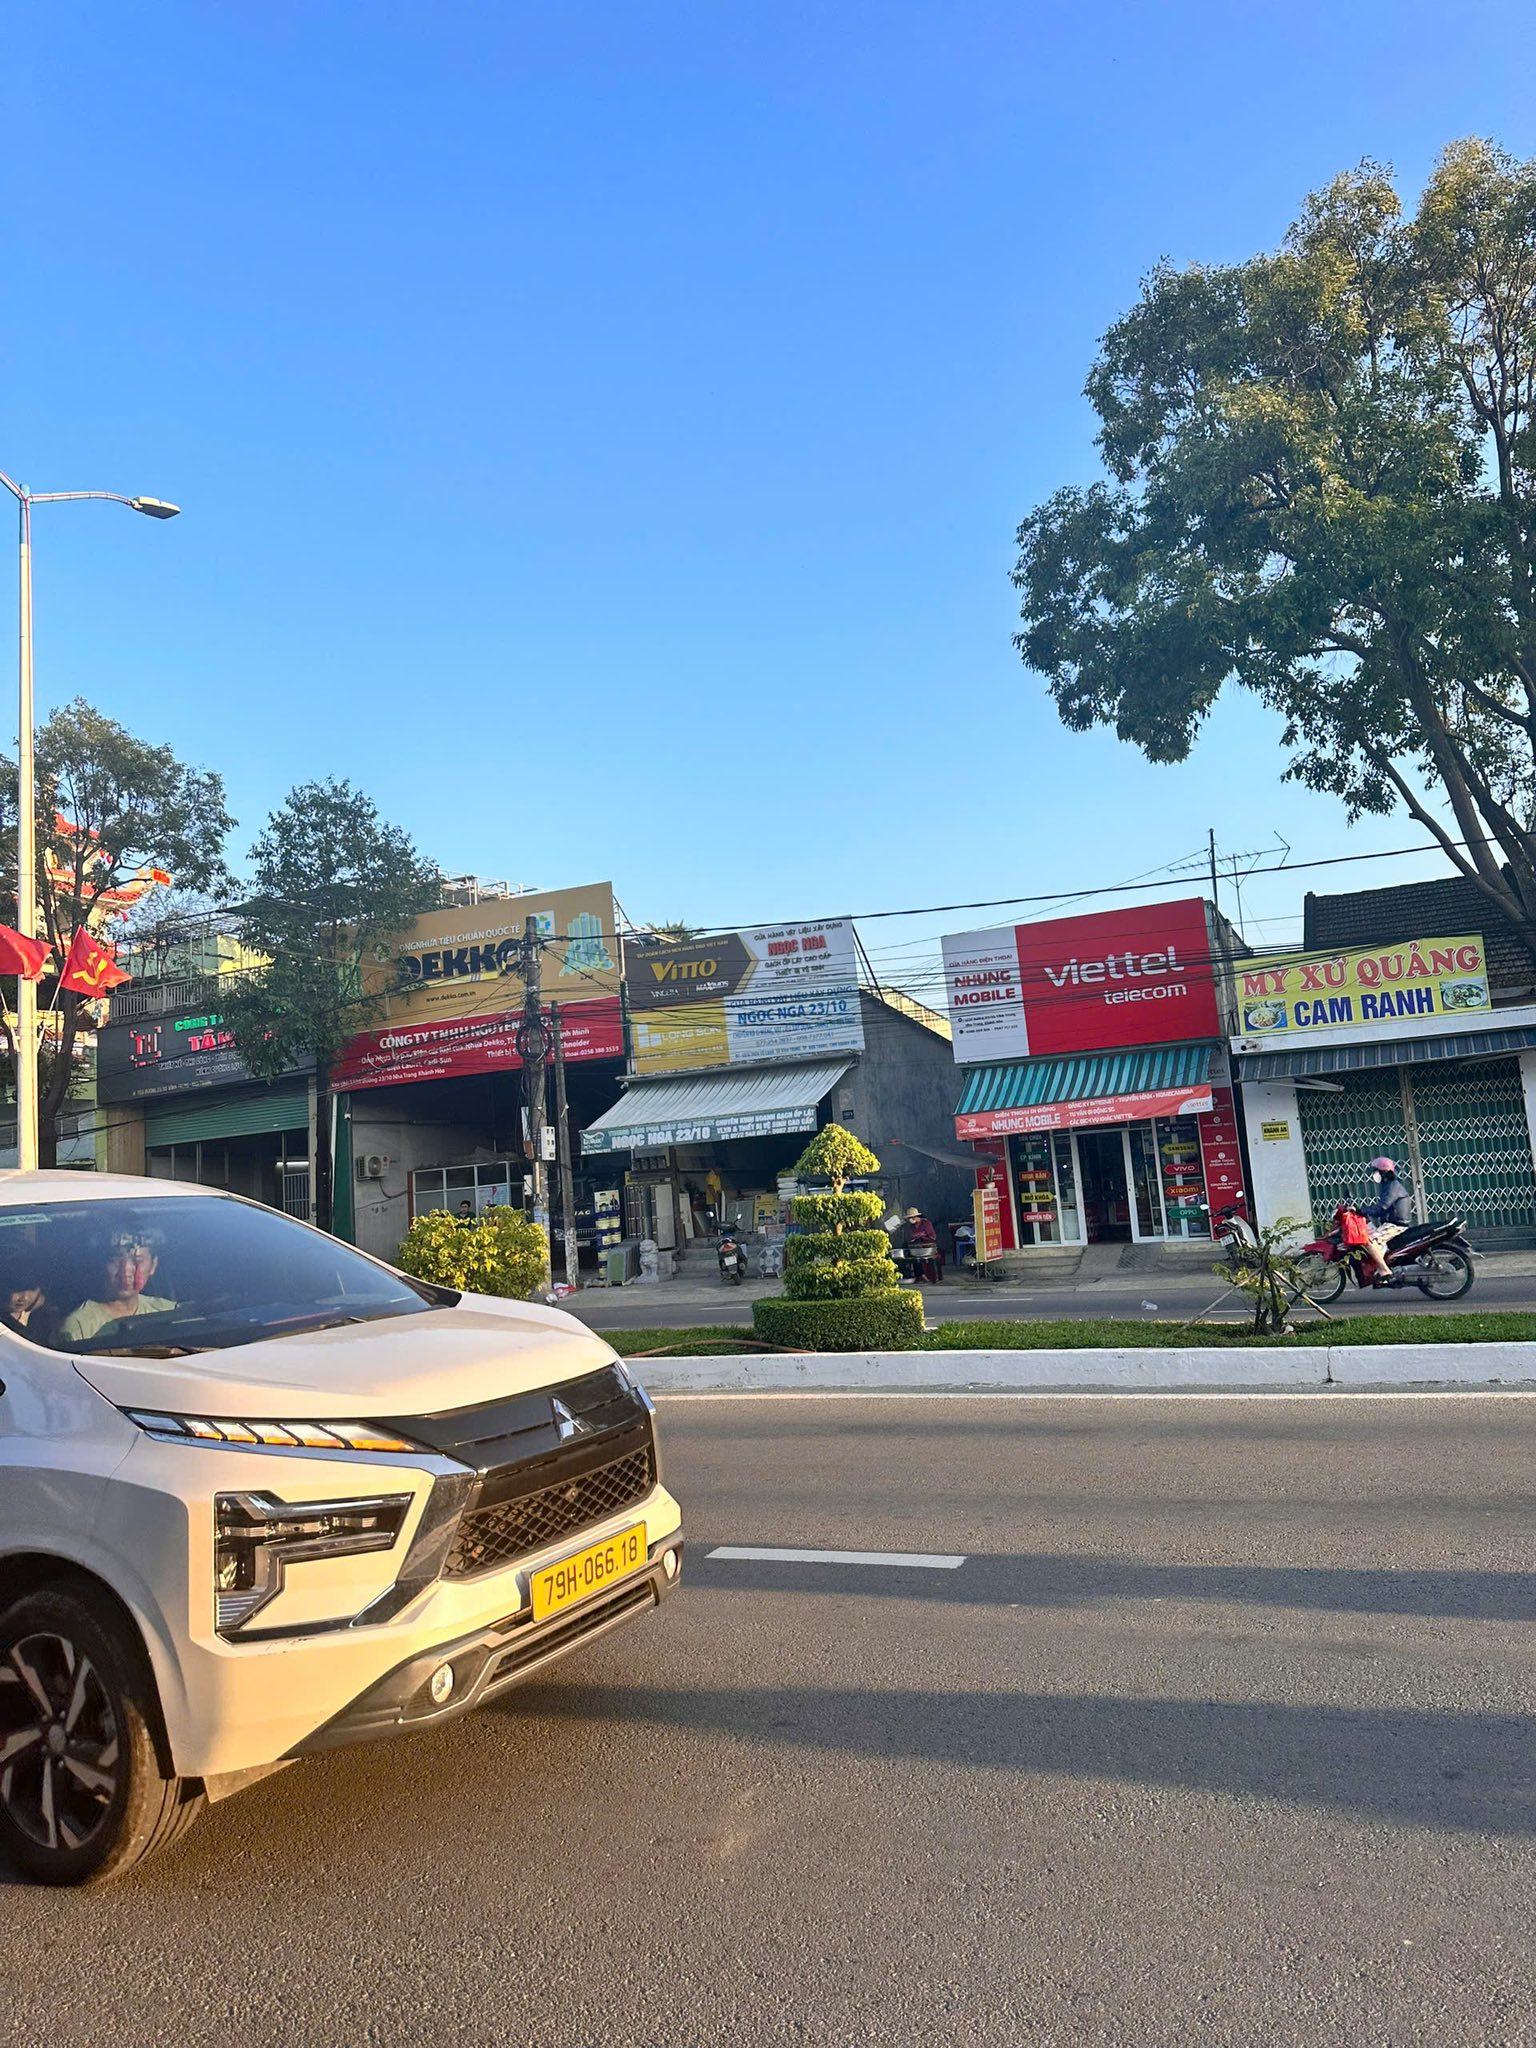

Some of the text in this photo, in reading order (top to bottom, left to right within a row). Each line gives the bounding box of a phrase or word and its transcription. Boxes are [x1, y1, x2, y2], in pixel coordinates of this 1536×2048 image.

[768, 935, 828, 957] NGỌC NGA
[1044, 945, 1185, 988] viettel
[1356, 941, 1483, 990] QUẢNG
[954, 970, 1011, 988] NHUNG
[953, 987, 1016, 1006] MOBILE
[1103, 983, 1187, 1005] telecom
[777, 1004, 807, 1019] NGA
[809, 999, 847, 1016] 23/10
[1294, 987, 1434, 1027] CAM RANH
[174, 1016, 208, 1032] CÔNG
[380, 1034, 413, 1049] CÔNG
[414, 1032, 430, 1045] TY
[991, 1117, 1025, 1131] NHUNG
[1025, 1113, 1061, 1128] MOBILE
[611, 1134, 645, 1150] NGỌC
[647, 1131, 674, 1146] NGA
[675, 1126, 711, 1142] 23/10
[544, 1535, 638, 1606] 79H-066.18
